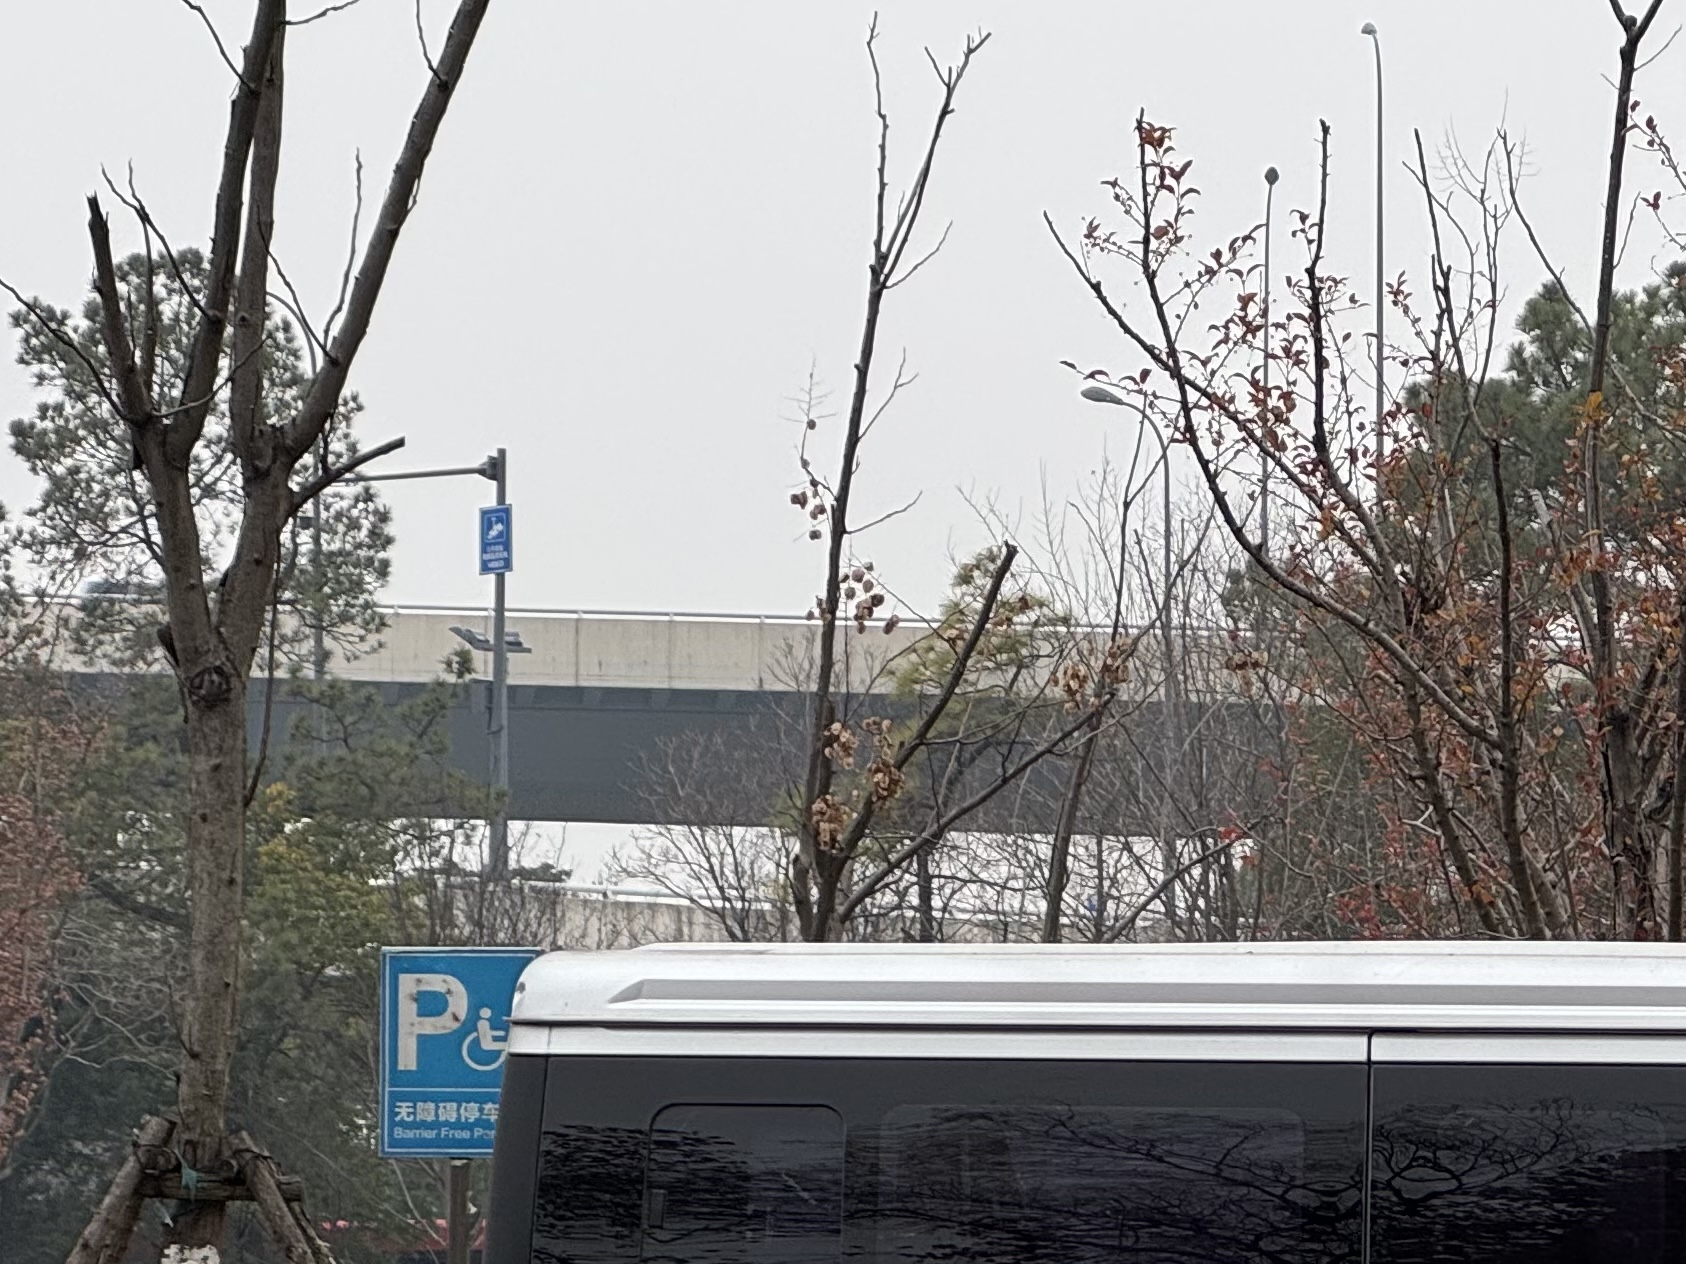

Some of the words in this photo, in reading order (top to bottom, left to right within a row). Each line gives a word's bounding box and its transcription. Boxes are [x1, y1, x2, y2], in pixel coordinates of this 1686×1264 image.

[398, 973, 468, 1071] P
[393, 1127, 438, 1139] Barrier
[440, 1127, 470, 1139] Free
